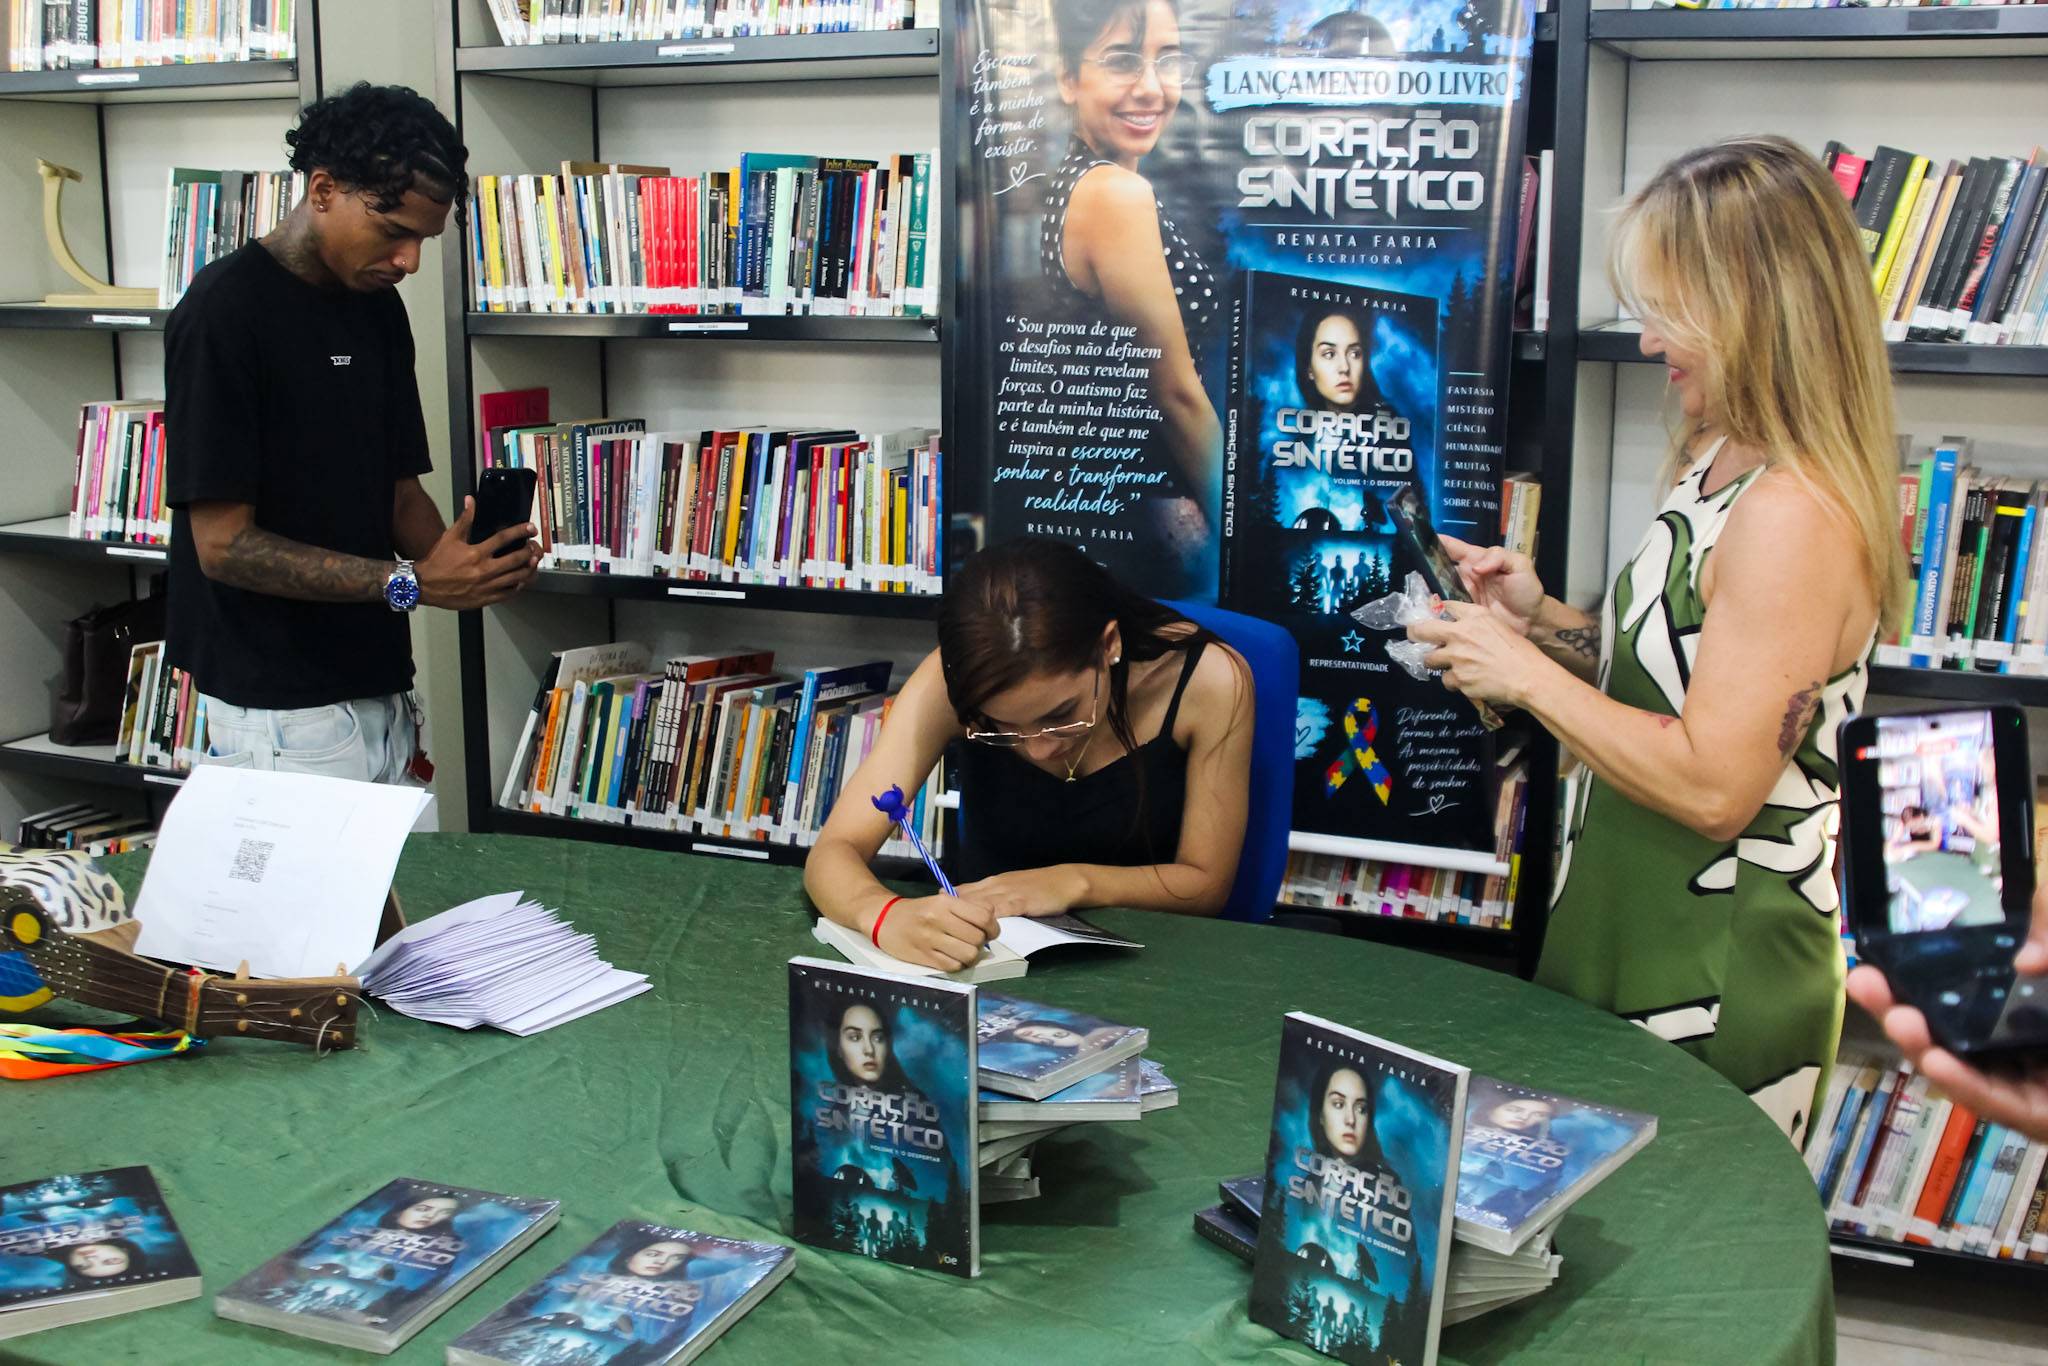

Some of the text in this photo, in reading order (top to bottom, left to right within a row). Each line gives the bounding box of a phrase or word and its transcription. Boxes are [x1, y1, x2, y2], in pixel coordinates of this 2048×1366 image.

[972, 49, 1037, 74] Escrever
[971, 74, 1032, 95] também
[1223, 68, 1512, 101] LANÇAMENTO DO LIVRO
[969, 91, 1046, 116] é a minha
[975, 115, 1046, 140] forma de
[984, 139, 1039, 159] existir.
[1243, 110, 1480, 172] CORAÇÃO
[1237, 160, 1484, 220] SINTÉTICO
[1277, 232, 1439, 249] RENATA FARIA
[1306, 252, 1405, 265] ESCRITORA
[1291, 287, 1408, 313] RENATA FARIA
[1046, 323, 1087, 338] prova
[1090, 321, 1107, 335] de
[1110, 325, 1137, 338] que
[1000, 339, 1162, 360] os desafios não definem
[1009, 357, 1149, 379] limites, mas revelam
[998, 377, 1148, 402] forças. O autismo faz
[1446, 384, 1496, 398] FANTASIA
[997, 400, 1164, 422] parte da minha história,
[1446, 403, 1495, 416] MISTÉRIO
[590, 422, 643, 435] MITOLOGIA
[999, 418, 1150, 441] e é também ele que me
[1276, 407, 1411, 447] CORAÇÃO
[1445, 420, 1487, 434] CIÊNCIA
[575, 432, 585, 476] MITOLOGIA
[1008, 439, 1146, 463] inspira a escrever,
[1272, 439, 1414, 476] SINTÉTICO
[1444, 441, 1503, 456] HUMANIDADE
[562, 445, 572, 489] MITOLOGIA
[993, 459, 1168, 495] sonhar e transformar
[1443, 460, 1491, 473] E MUITAS
[577, 477, 586, 504] GREGA
[1333, 477, 1362, 487] VOLUME
[1370, 479, 1376, 487] O
[1442, 477, 1496, 492] REFLEXÕES
[565, 490, 573, 518] GREGA
[1024, 488, 1141, 516] realidades.”
[1225, 473, 1236, 537] SINTÉTICO
[1442, 496, 1472, 509] SOBRE
[1473, 499, 1481, 509] A
[1027, 523, 1135, 541] RENATA FARIA
[1921, 568, 1939, 635] FILOSOFANDO
[1309, 658, 1389, 673] REPRESENTATIVIDADE
[1397, 707, 1457, 726] Diferentes
[1397, 725, 1485, 744] formas de sentir
[1399, 742, 1460, 758] As mesmas
[1405, 758, 1481, 776] possibilidades
[1412, 775, 1467, 790] de sonhar
[814, 980, 941, 1011] RENATA FARIA
[1306, 1037, 1428, 1088] RENATA FARIA
[818, 1081, 940, 1124] CORAÇÃO
[815, 1107, 945, 1151] SINTÉTICO
[1294, 1147, 1413, 1213] CORAÇÃO
[1289, 1174, 1413, 1243] SINTÉTICO
